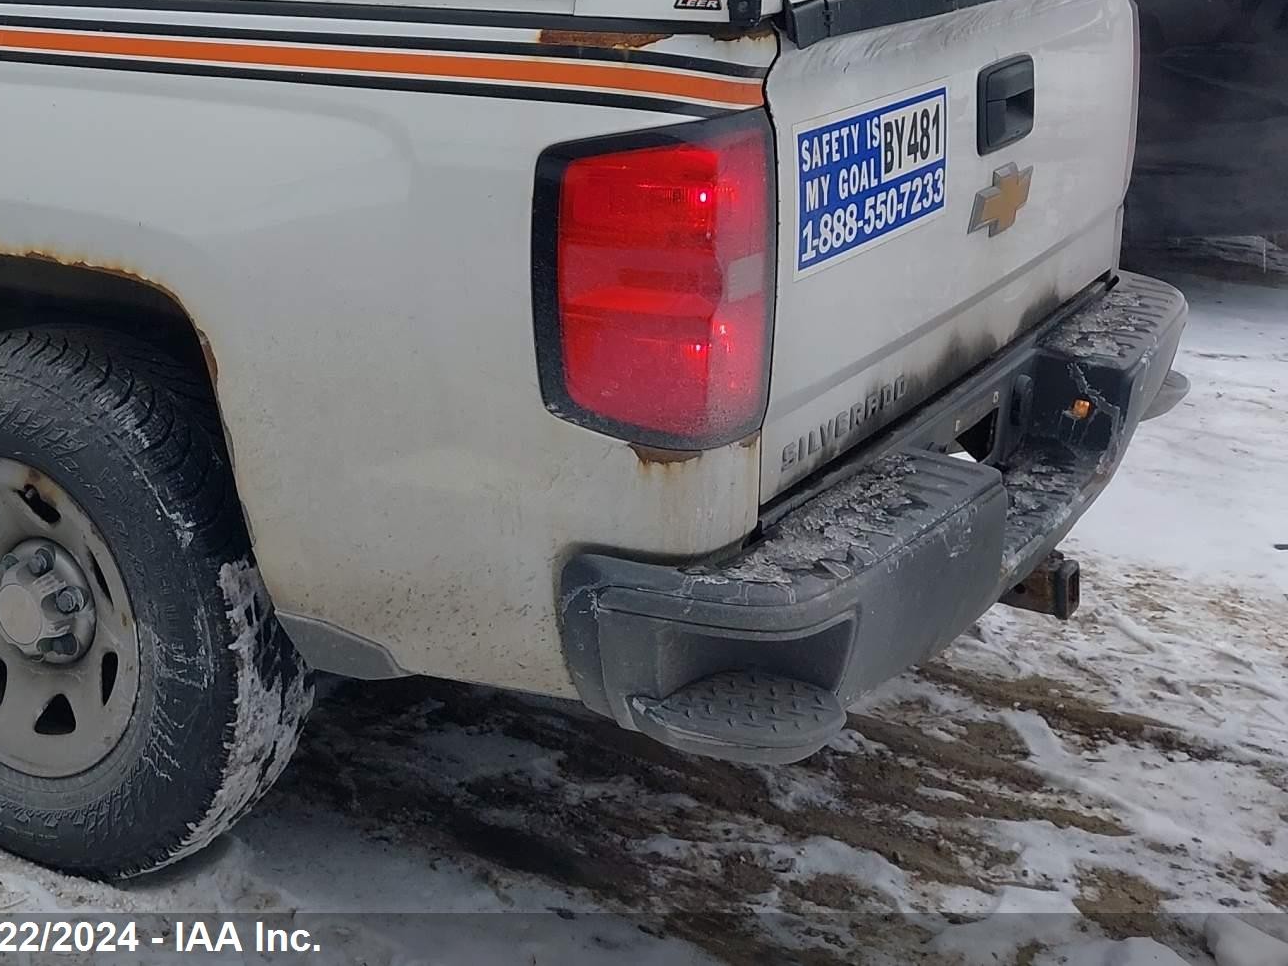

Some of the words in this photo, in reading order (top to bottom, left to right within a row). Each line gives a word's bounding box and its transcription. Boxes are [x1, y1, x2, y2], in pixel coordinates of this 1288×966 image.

[676, 0, 718, 8] LEER
[801, 122, 860, 173] SAFETY
[866, 116, 881, 150] IS
[883, 103, 941, 175] BY481
[801, 167, 945, 263] 1-888-550-7233
[805, 173, 831, 213] MY
[838, 157, 879, 201] GOAL
[781, 373, 907, 473] SILVERADO
